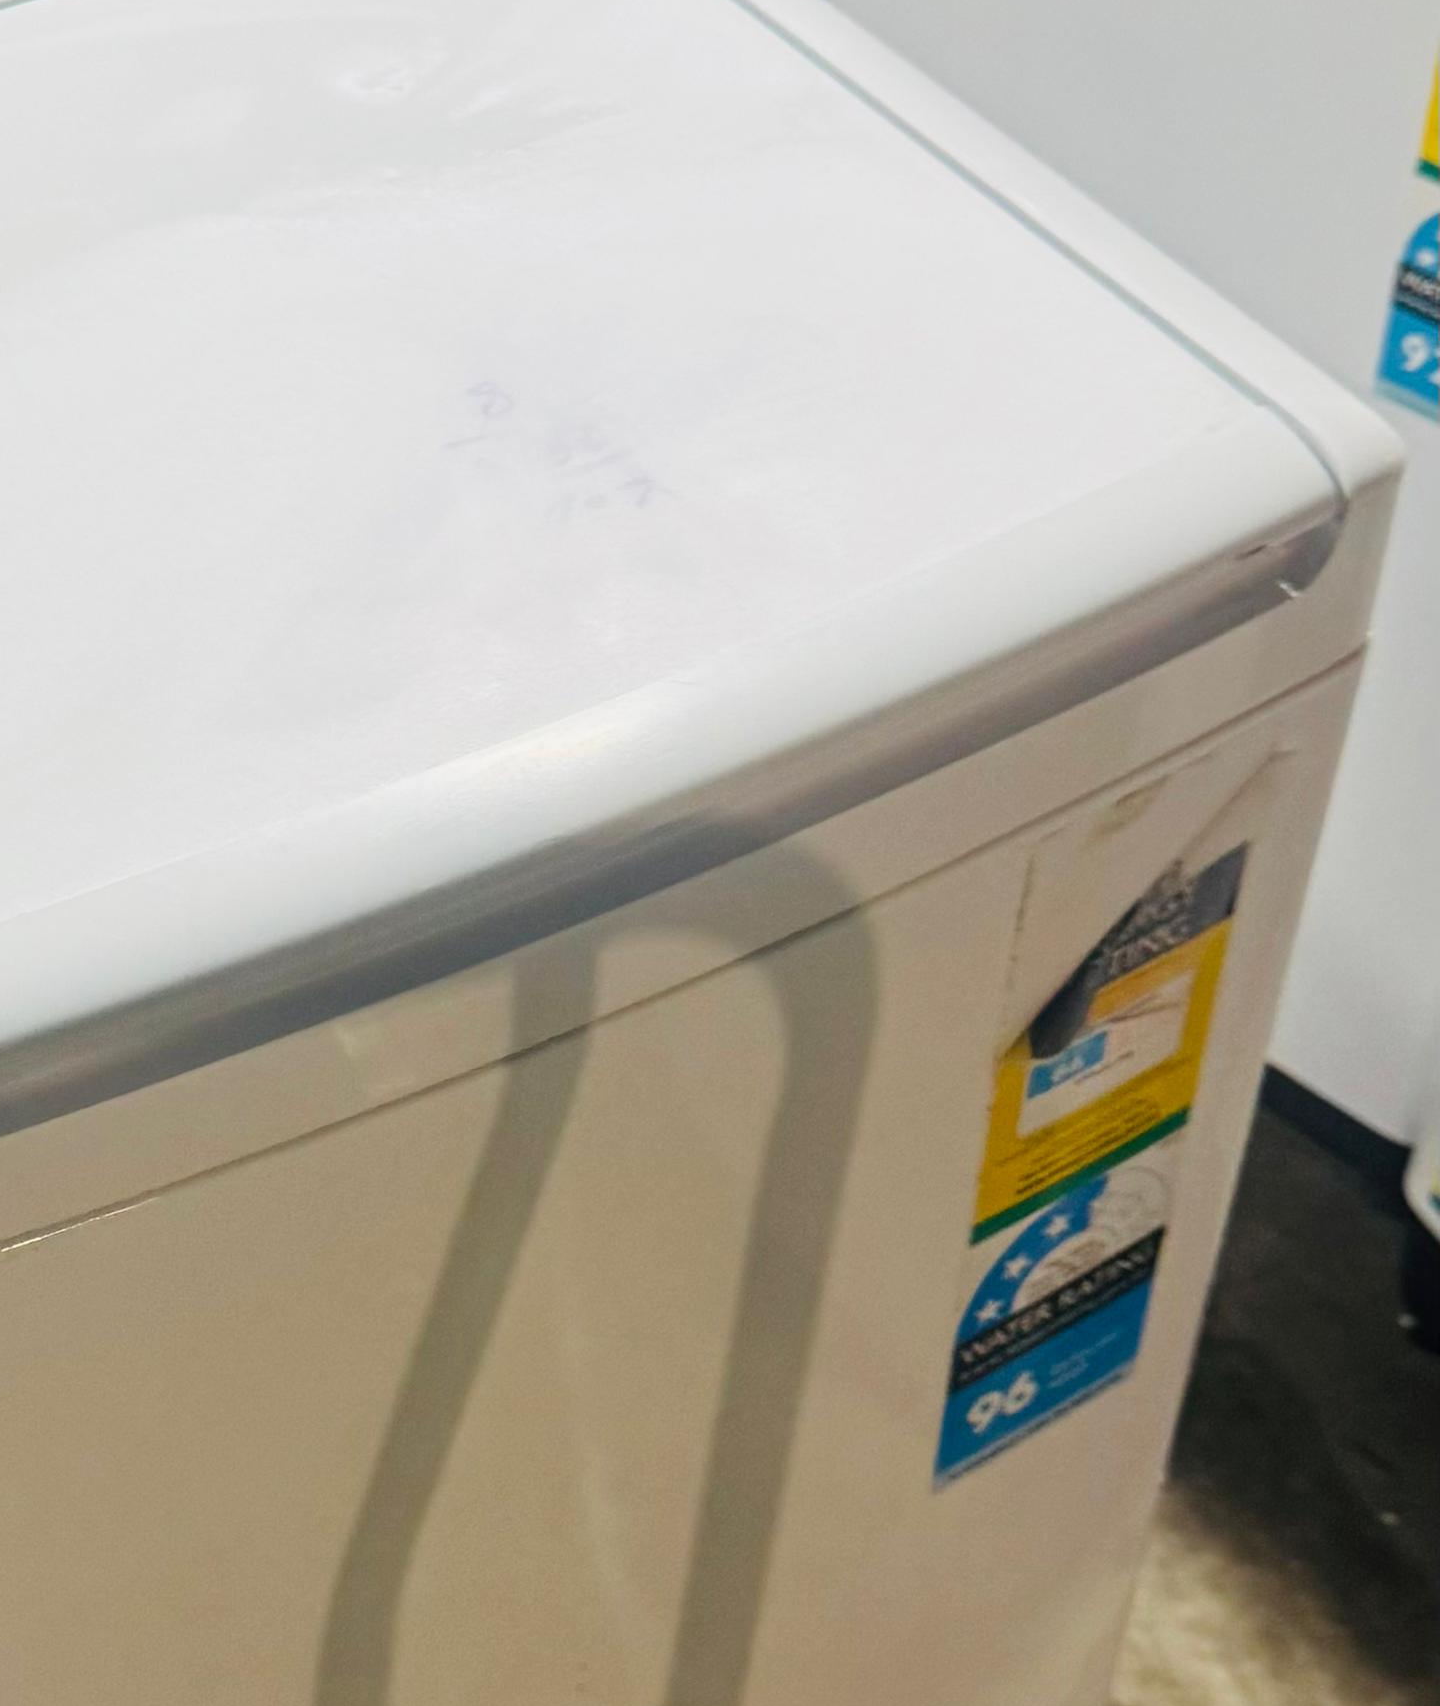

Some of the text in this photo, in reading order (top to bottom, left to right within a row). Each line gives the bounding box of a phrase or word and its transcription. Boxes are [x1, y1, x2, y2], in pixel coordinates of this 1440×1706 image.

[960, 1302, 1052, 1363] WATER
[1058, 1249, 1154, 1307] RATING
[966, 1370, 1040, 1435] 96
